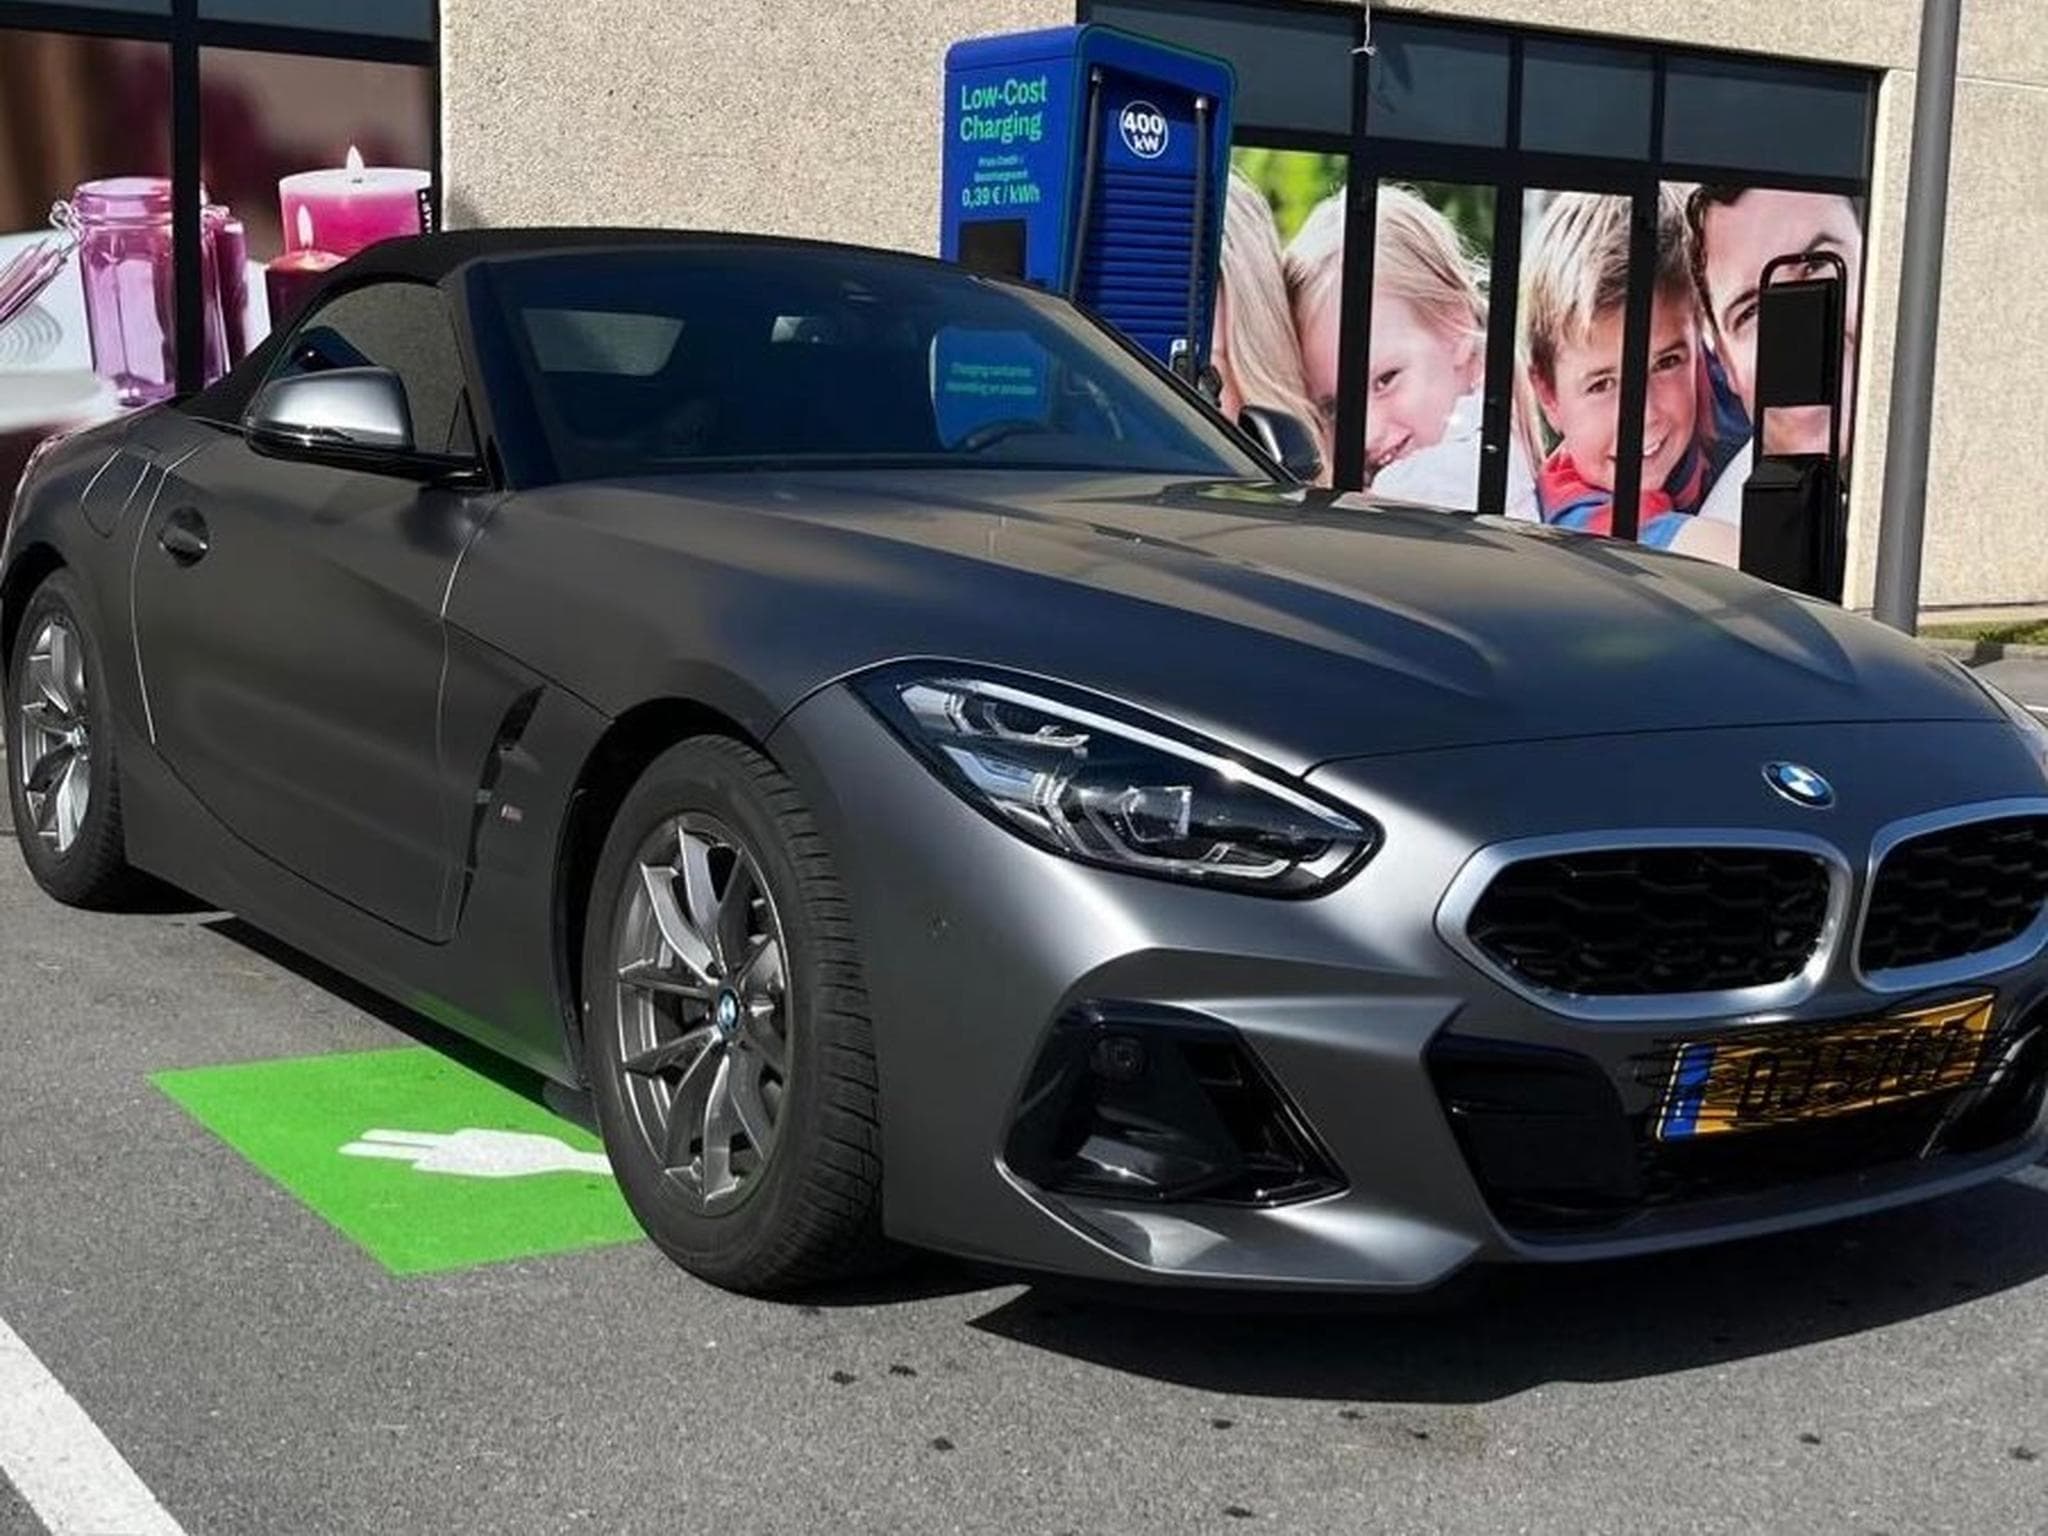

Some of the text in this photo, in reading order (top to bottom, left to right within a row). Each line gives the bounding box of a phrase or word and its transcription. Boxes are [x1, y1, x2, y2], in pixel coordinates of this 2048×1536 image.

[962, 75, 1046, 110] Low-Cost
[960, 110, 1042, 144] Charging
[1124, 111, 1162, 135] 400
[1133, 135, 1158, 151] kW
[962, 187, 990, 208] 0,39
[1009, 183, 1041, 204] kWh
